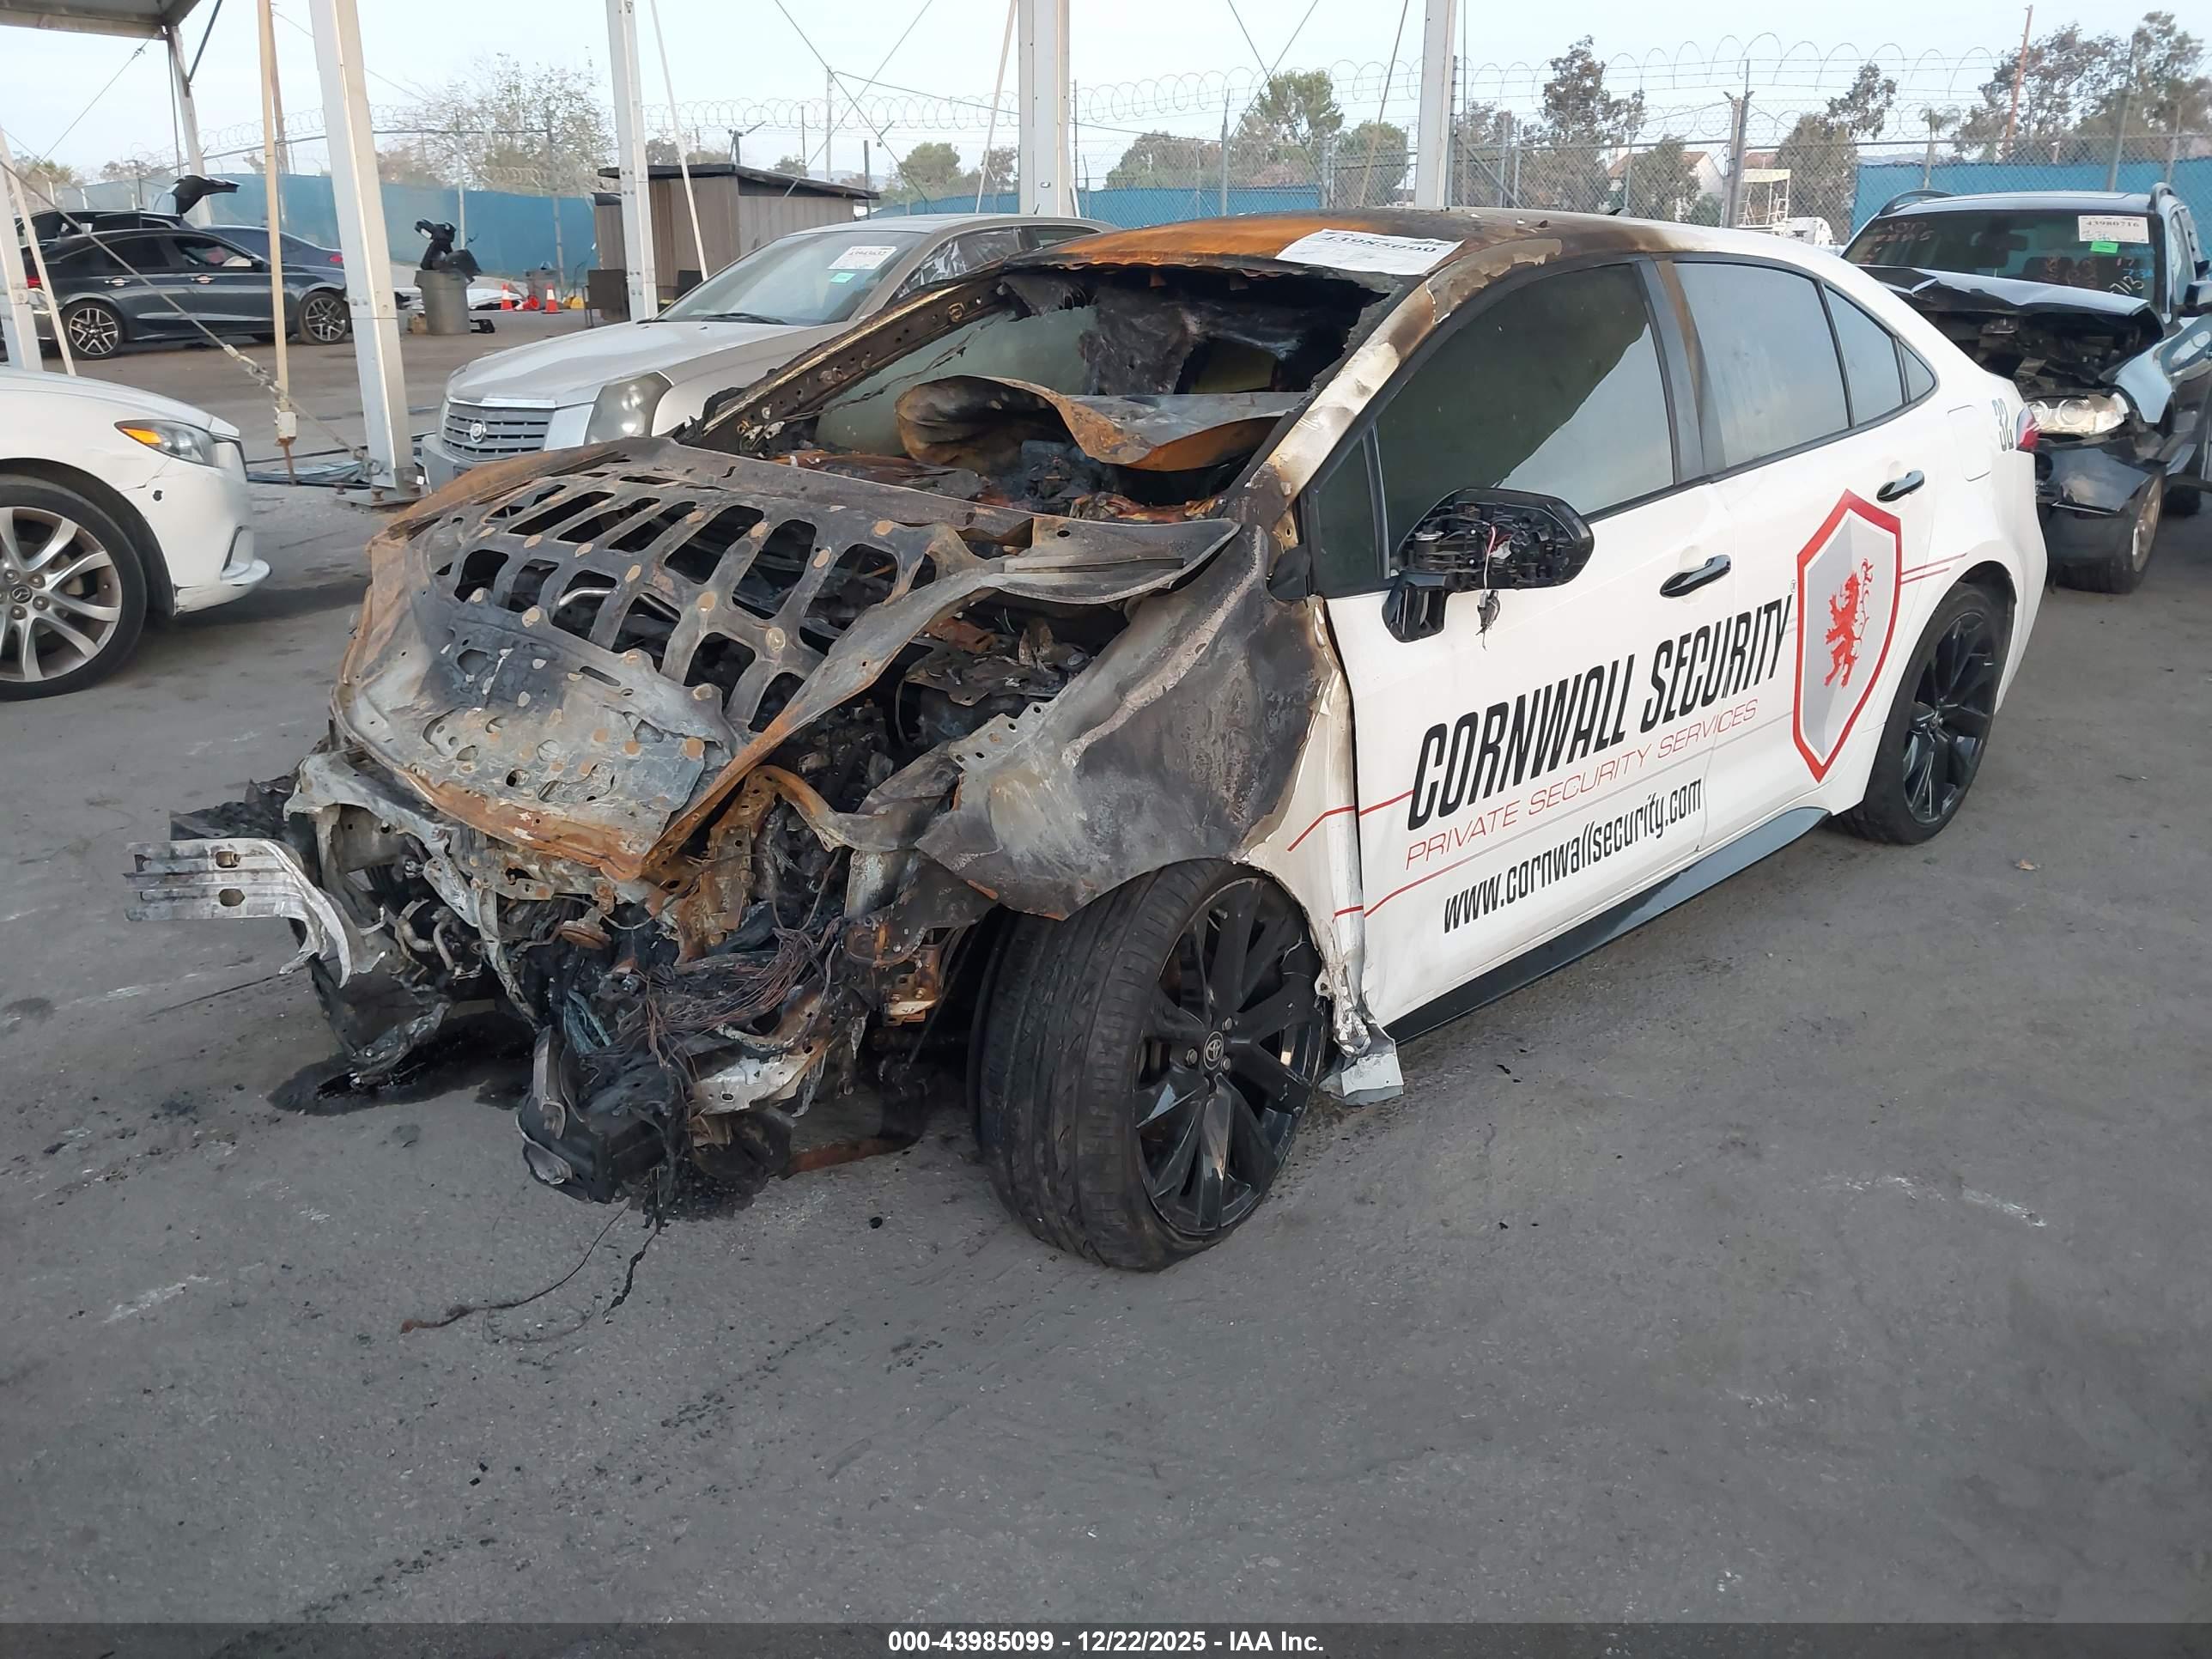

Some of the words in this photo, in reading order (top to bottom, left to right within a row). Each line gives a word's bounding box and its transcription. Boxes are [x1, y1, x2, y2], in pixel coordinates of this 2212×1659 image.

[1406, 795, 1522, 871] PRIVATE
[1528, 743, 1652, 817] SECURITY
[1657, 698, 1759, 759] SERVICES
[1407, 653, 1636, 831] CORNWALL
[1640, 592, 1794, 733] SECURITY
[1443, 777, 1703, 934] www.cornwallsecurity.com
